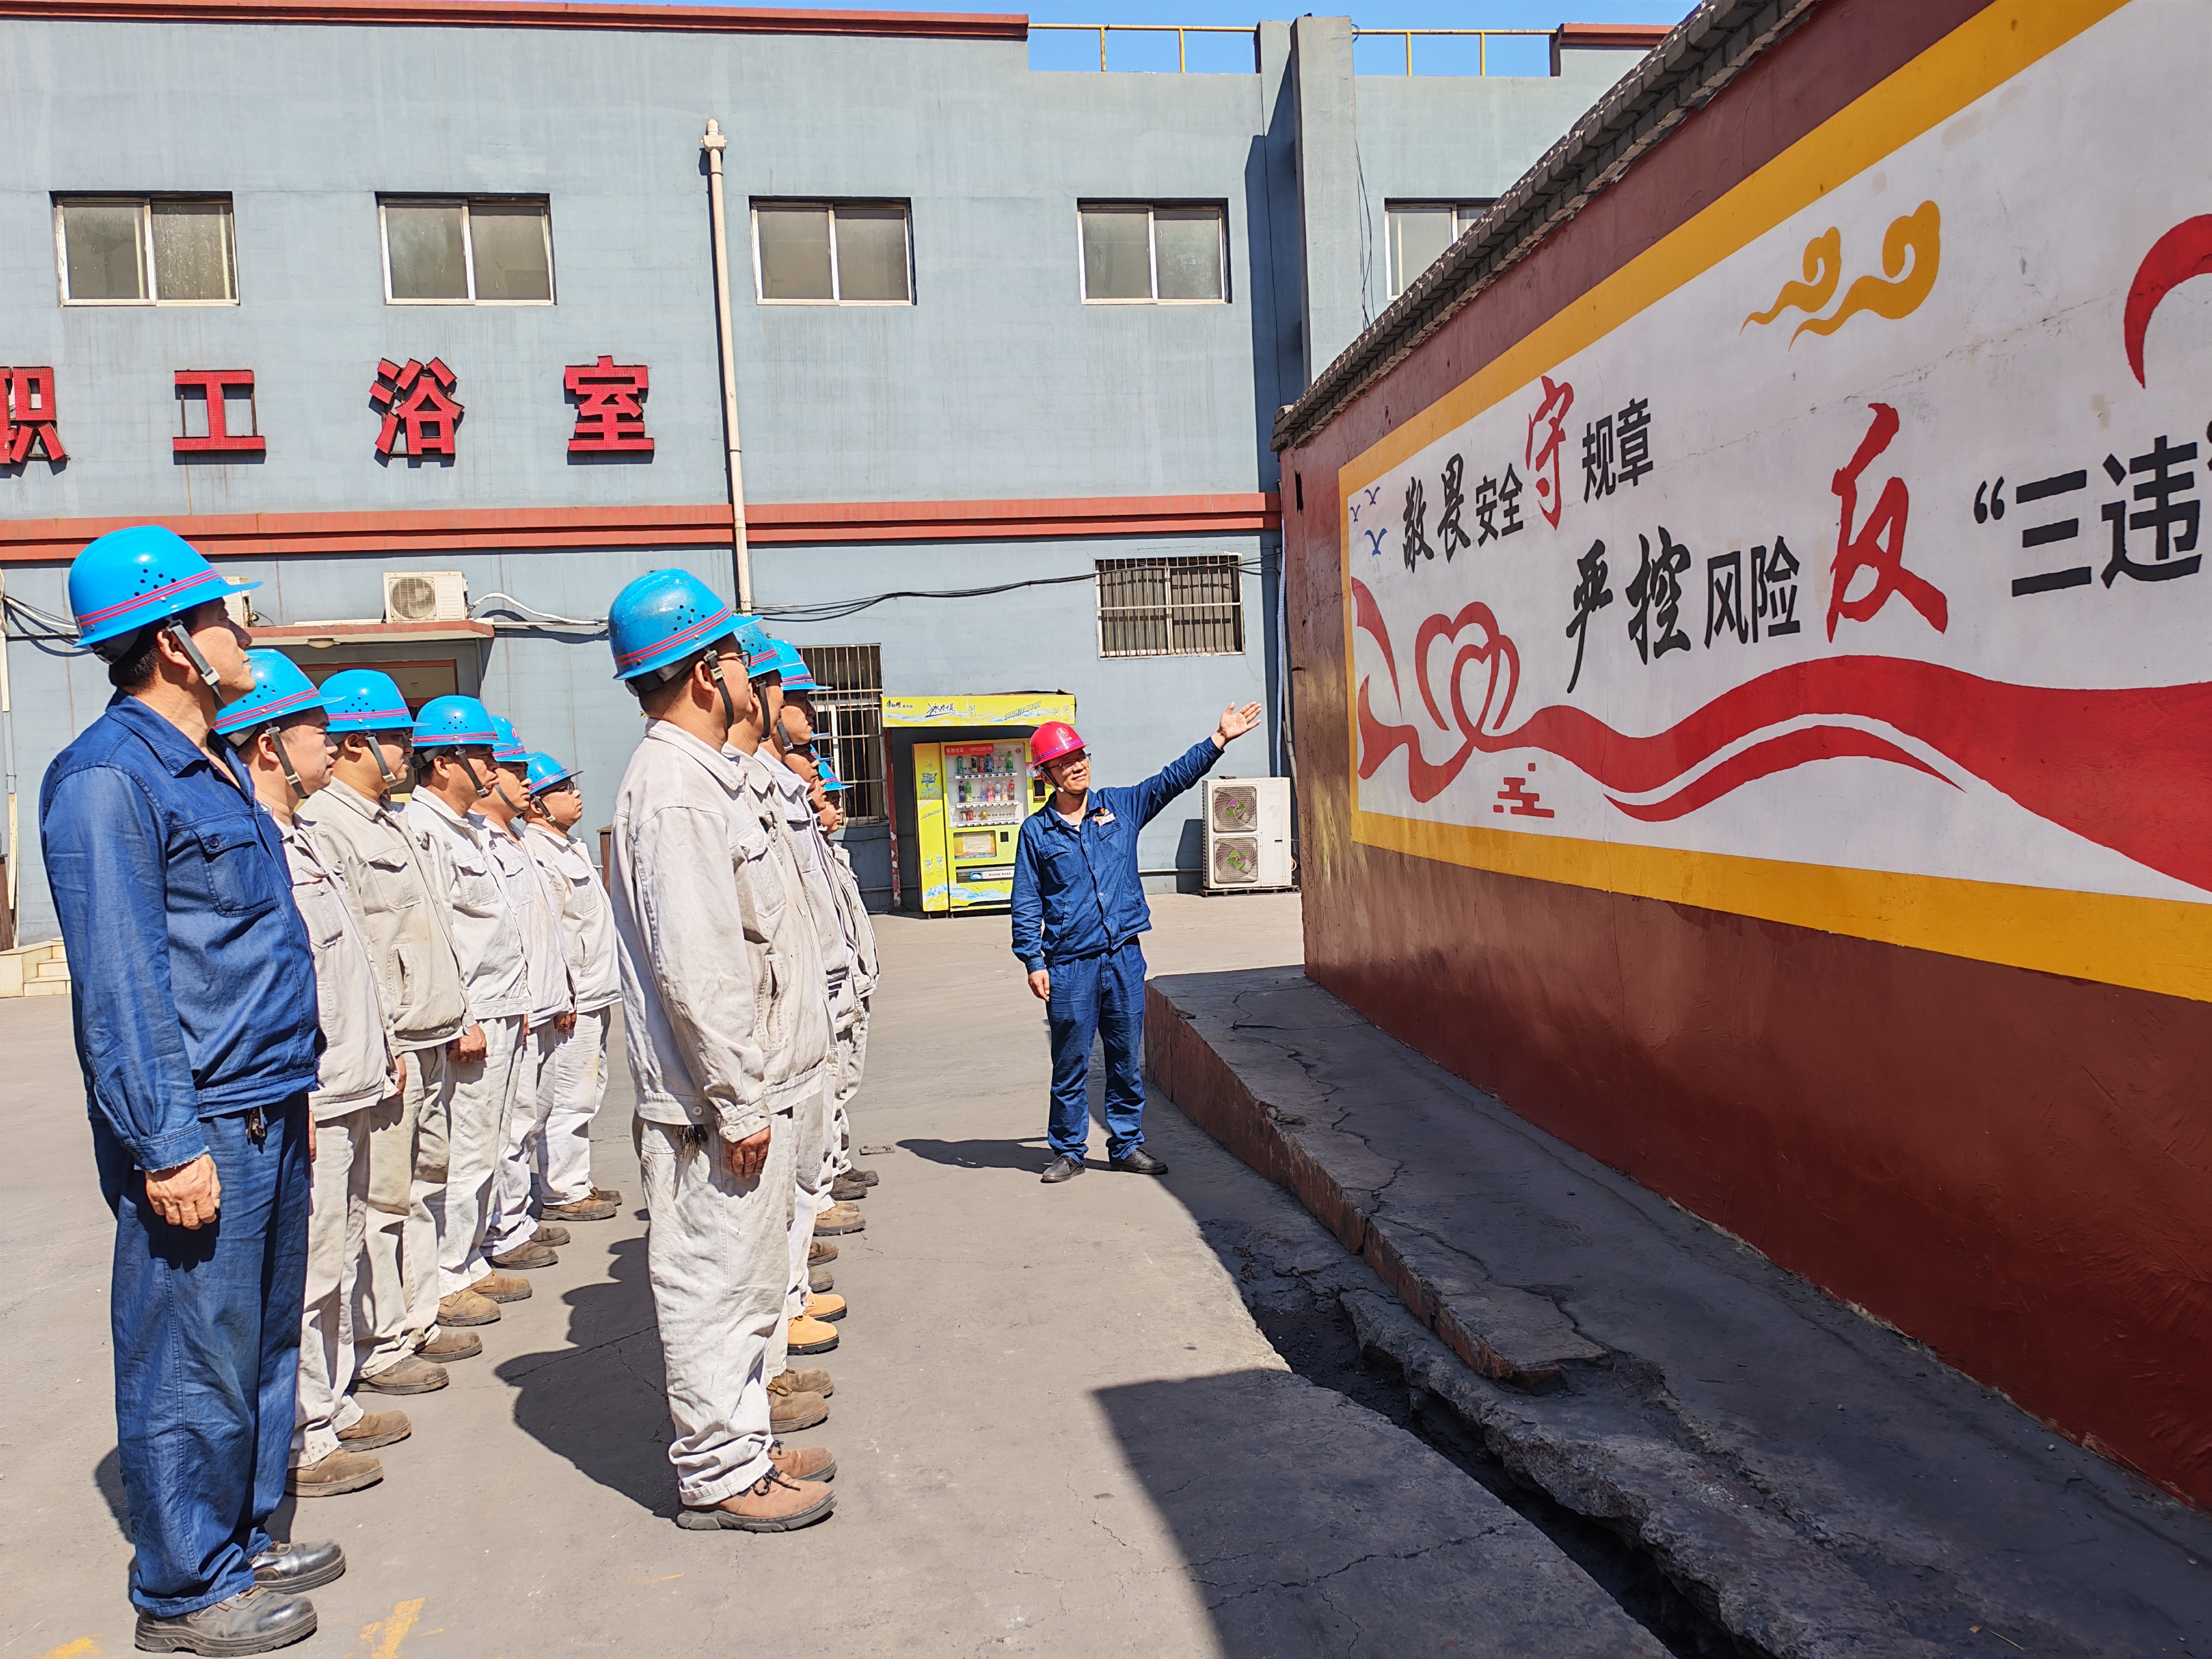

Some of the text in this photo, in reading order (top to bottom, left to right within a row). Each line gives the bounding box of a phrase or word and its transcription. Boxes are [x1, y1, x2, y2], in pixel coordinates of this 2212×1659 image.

[1403, 375, 1654, 574] 敬畏安全守规章
